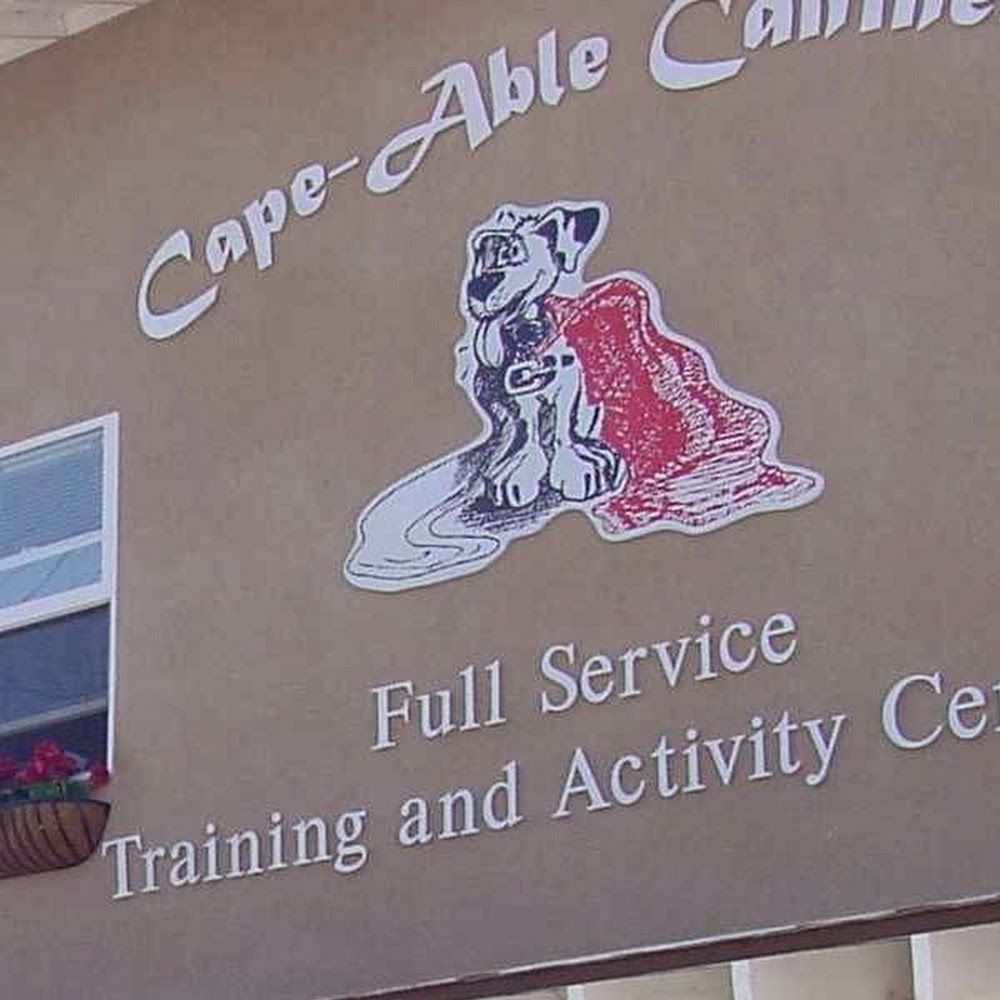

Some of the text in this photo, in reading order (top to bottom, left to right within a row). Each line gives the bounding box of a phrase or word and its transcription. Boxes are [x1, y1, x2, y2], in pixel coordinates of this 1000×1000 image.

[137, 30, 609, 340] Cape-Able
[101, 671, 1000, 902] Training and Activity Ce
[370, 612, 799, 752] Full Service
